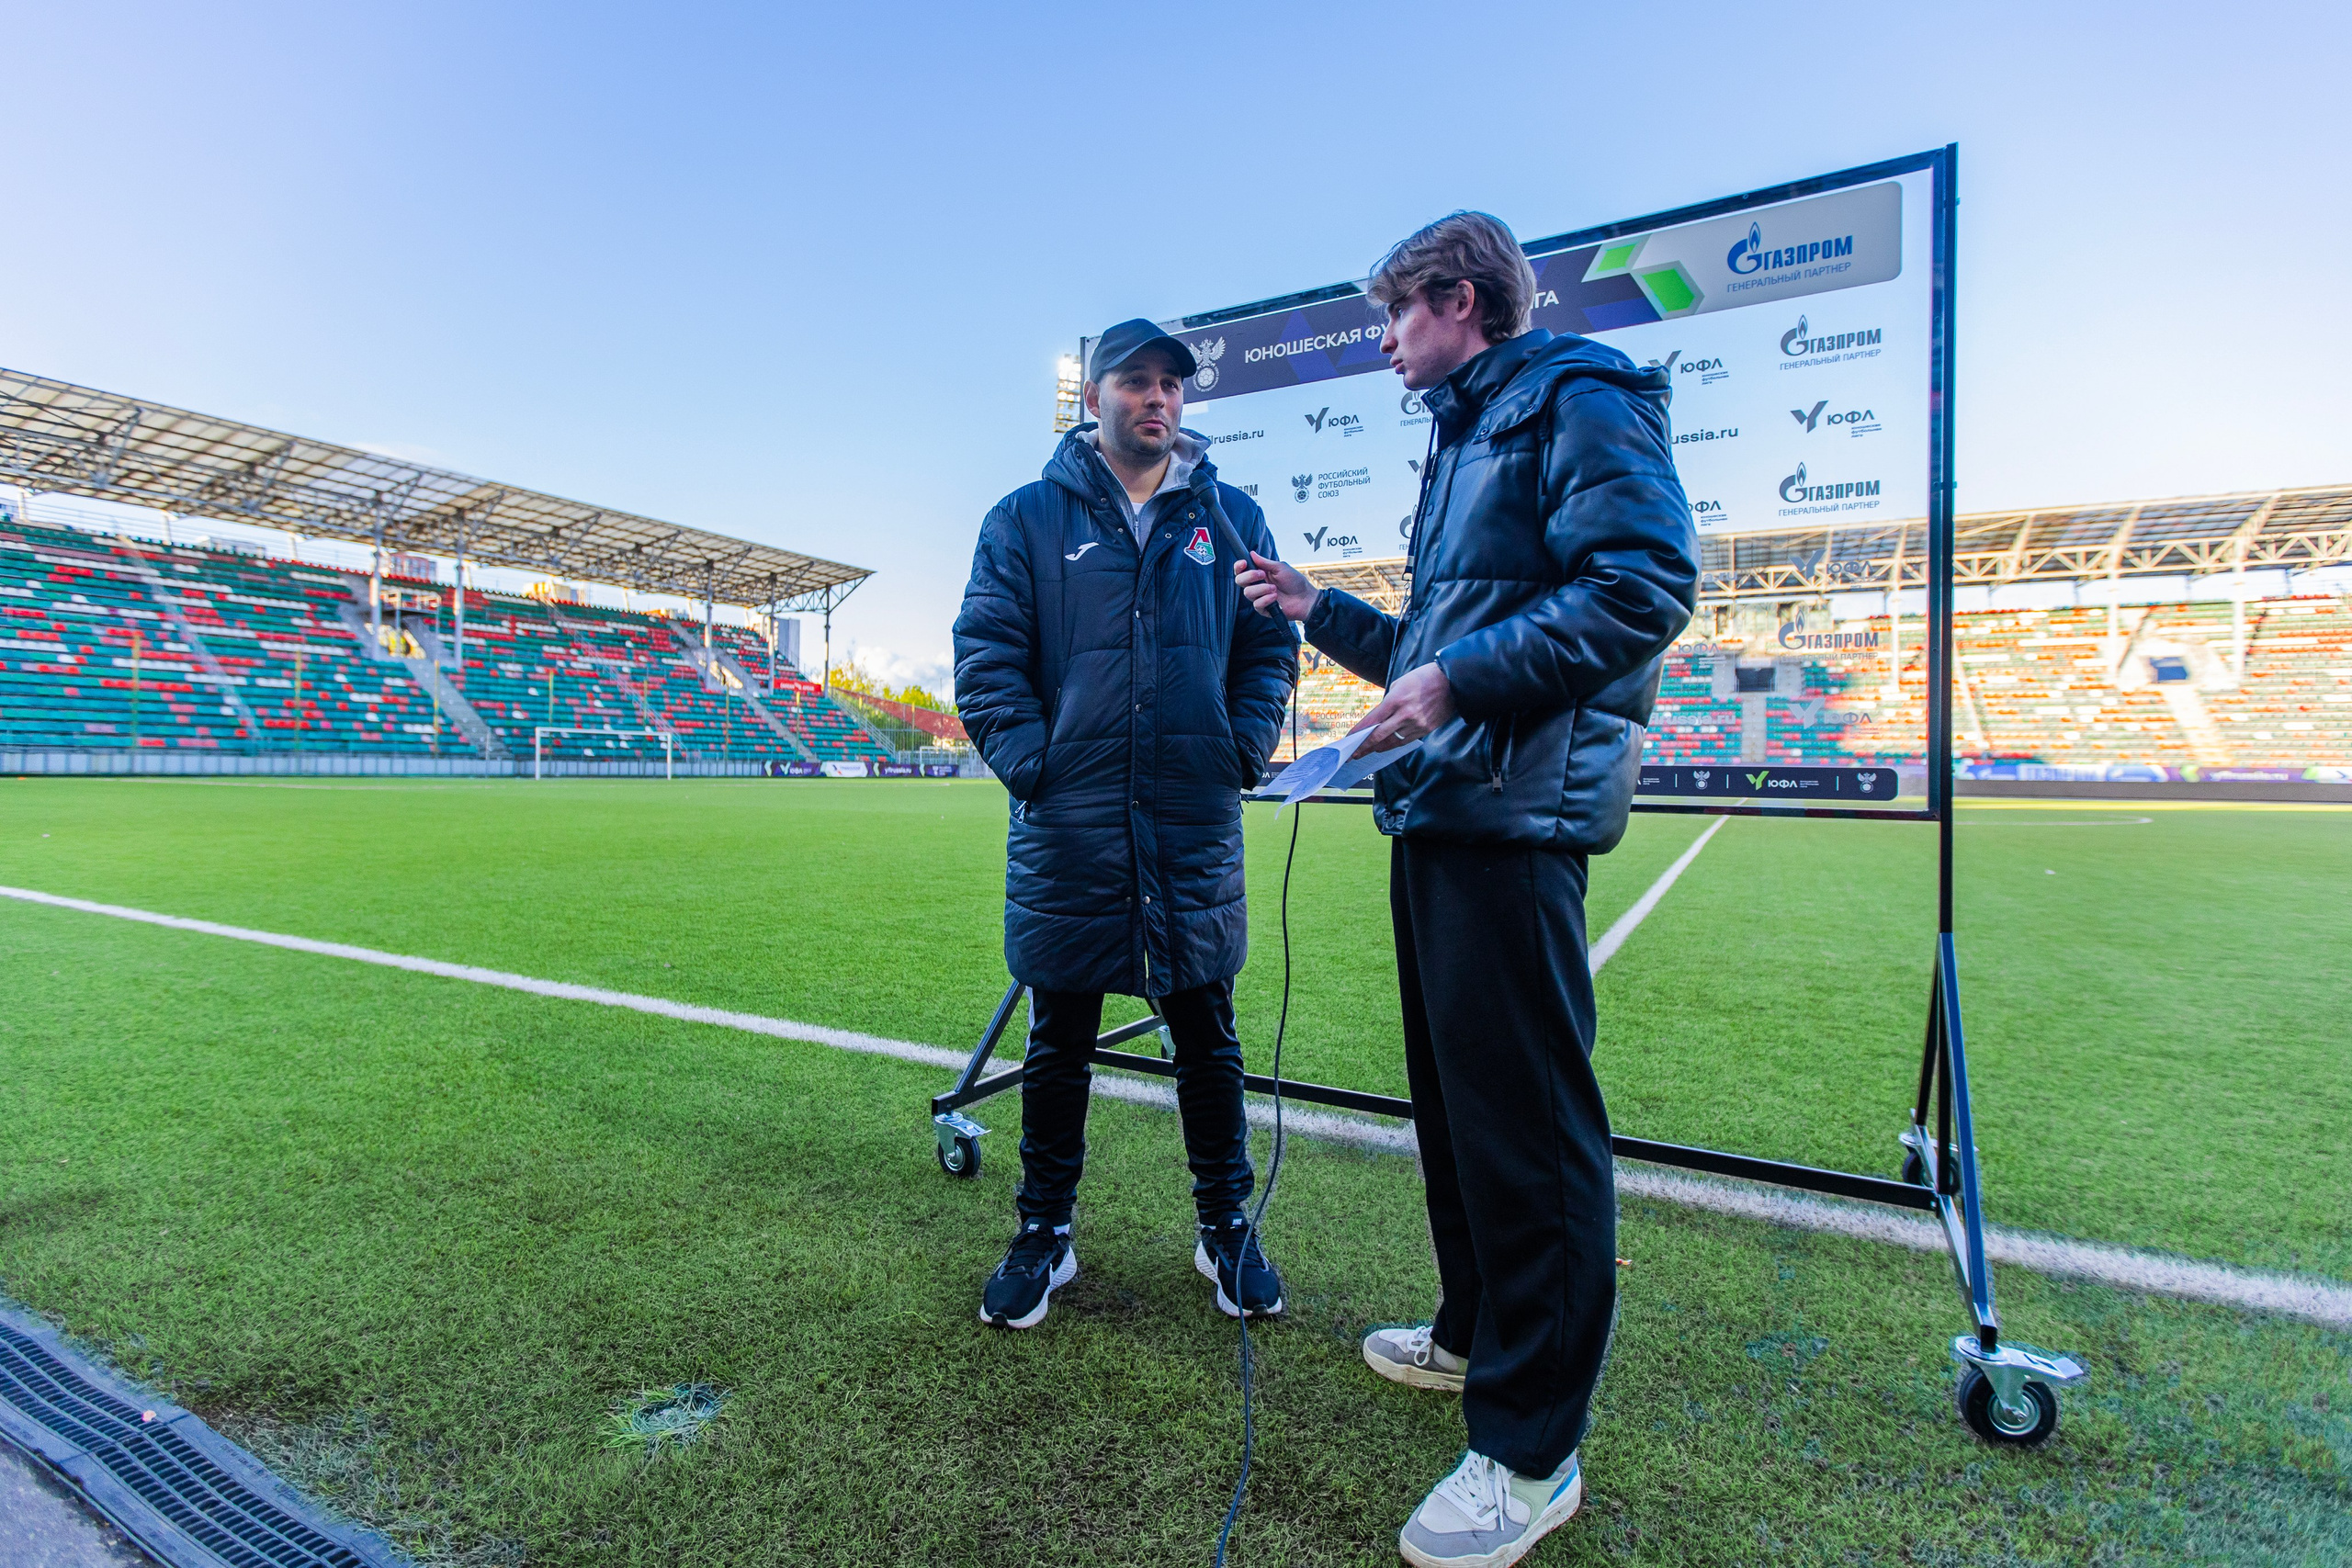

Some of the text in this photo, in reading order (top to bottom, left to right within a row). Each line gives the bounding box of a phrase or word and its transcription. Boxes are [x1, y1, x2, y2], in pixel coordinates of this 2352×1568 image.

[1764, 235, 1853, 271] ГАЗПРОМ
[1726, 262, 1852, 293] ГЕНЕРАЛЬНЫЙ ПАРТНЕР
[1245, 328, 1362, 364] ЮНОШЕСКАЯ
[1531, 289, 1560, 310] ГА
[1810, 328, 1882, 355] ГАЗПРОМ
[1680, 358, 1724, 374] ЮФЛ
[1780, 349, 1882, 370] ГЕНЕРАЛЬНЫЙ ПАРТНЕР
[1329, 414, 1360, 427] ЮФЛ
[1827, 410, 1875, 425] ЮФЛ
[1207, 430, 1265, 446] lrussia.ru
[1670, 428, 1738, 445] ussia.ru
[1317, 467, 1368, 480] РОССИЙСКИЙ
[1317, 477, 1371, 490] ФУТБОЛЬНЫЙ
[1809, 479, 1880, 502] ГАЗПРОМ
[1317, 490, 1340, 499] СОЮЗ
[1779, 501, 1881, 517] ГЕНЕРАЛЬНЫЙ ПАРТНЕР
[1327, 536, 1359, 547] ЮФЛ
[1807, 632, 1879, 649] ГАЗПРОМ
[1768, 779, 1798, 789] ЮФЛ
